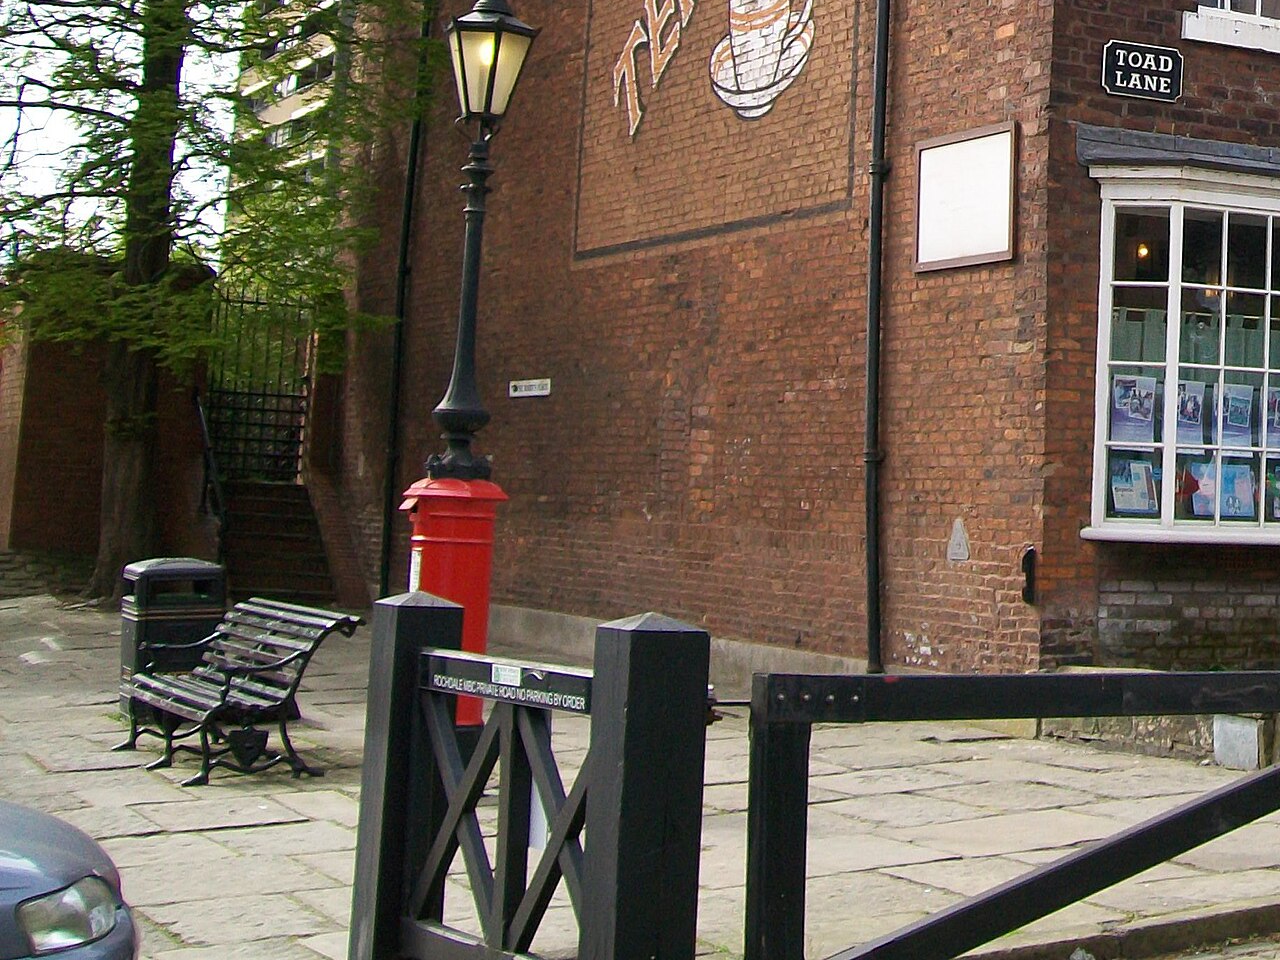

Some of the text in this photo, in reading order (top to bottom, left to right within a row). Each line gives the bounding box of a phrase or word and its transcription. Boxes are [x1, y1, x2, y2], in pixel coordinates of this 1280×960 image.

[1115, 49, 1173, 72] TOAD
[1115, 71, 1171, 93] LANE
[433, 674, 463, 691] ROCHDALE
[477, 682, 499, 697] PRIVATE
[499, 686, 516, 699] ROAD
[517, 688, 525, 701] NO
[526, 689, 553, 705] PARKING
[553, 693, 562, 706] BY
[562, 694, 585, 710] ORDER
